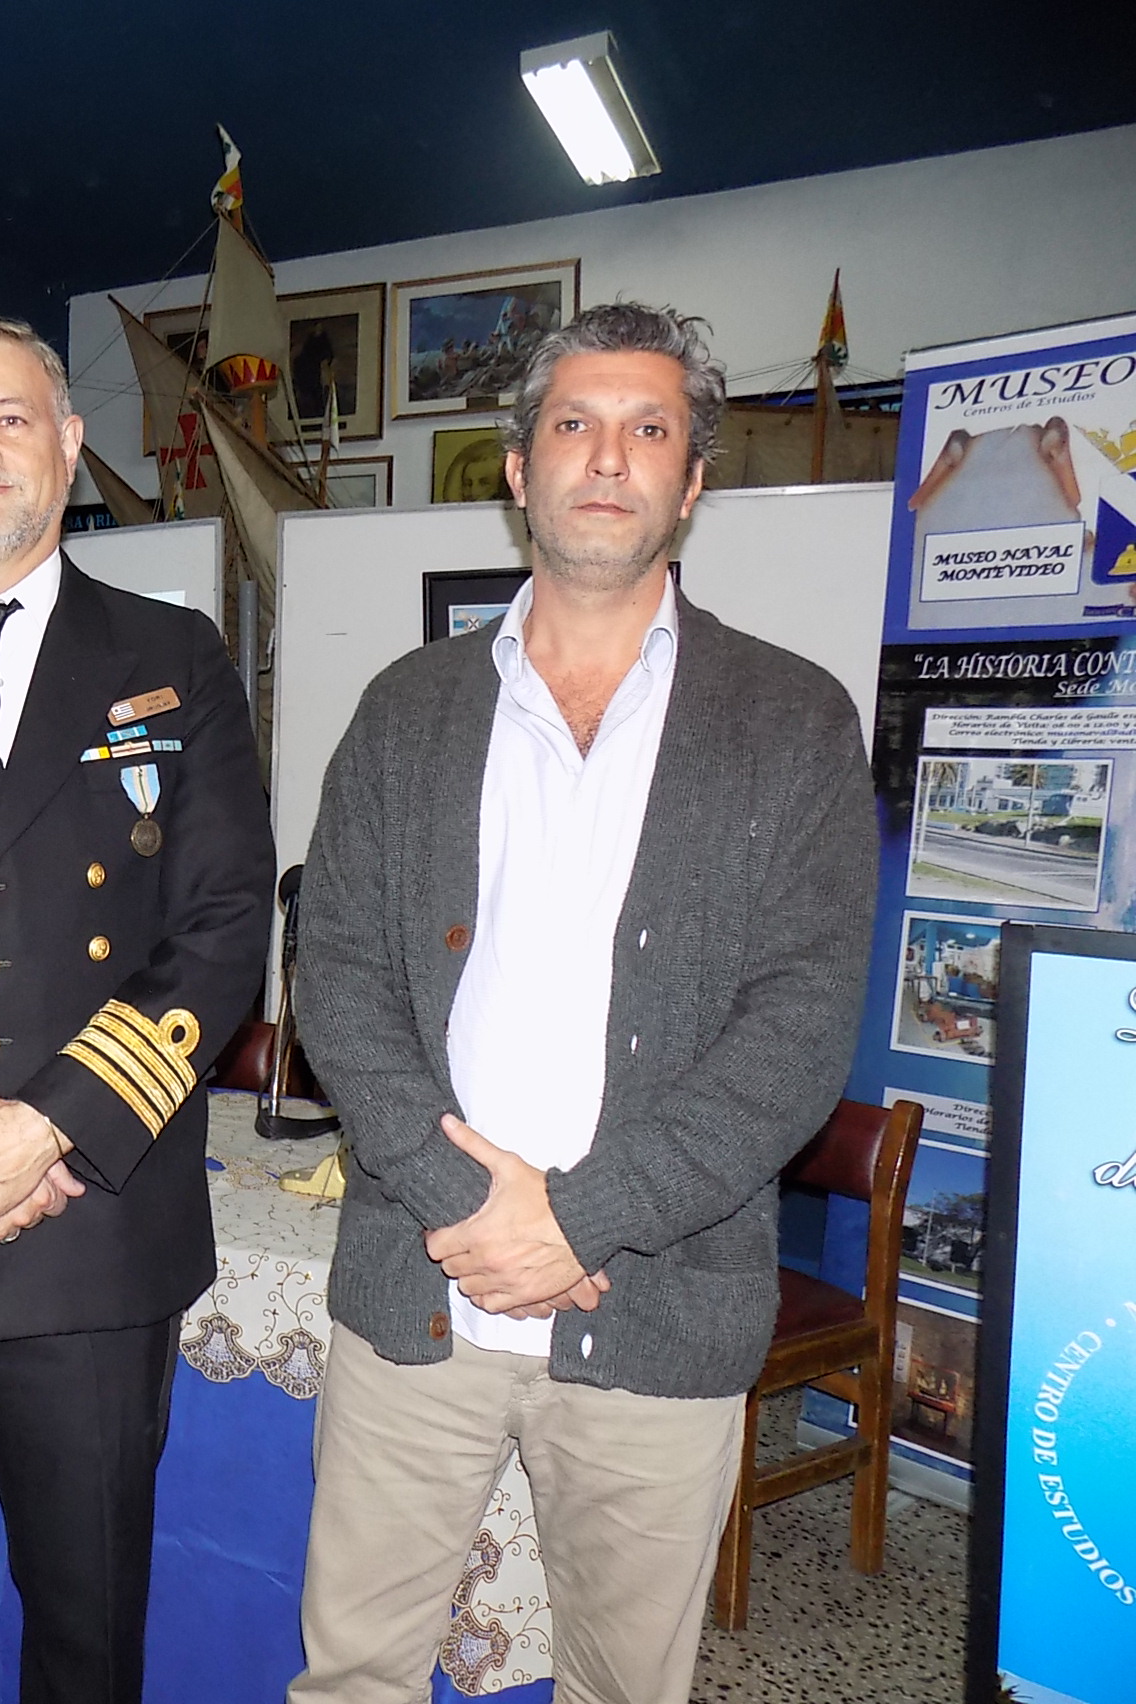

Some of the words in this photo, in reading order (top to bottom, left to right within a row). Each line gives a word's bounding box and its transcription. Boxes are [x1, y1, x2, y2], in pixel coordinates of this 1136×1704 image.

[934, 355, 1136, 410] MUSEO
[963, 404, 1013, 418] Centros
[1016, 400, 1032, 410] de
[1037, 391, 1096, 407] Estudios
[932, 550, 996, 566] MUSEO
[1000, 545, 1073, 562] NAVAL
[937, 562, 1065, 582] MONTEVIDEO
[954, 652, 1068, 679] HISTORIA
[1073, 650, 1136, 677] CONT
[1055, 678, 1100, 695] Sede
[1070, 712, 1083, 720] de
[1033, 1330, 1103, 1423] CENTRO
[1032, 1427, 1059, 1466] DE
[1038, 1472, 1136, 1606] ESTUDIOS
